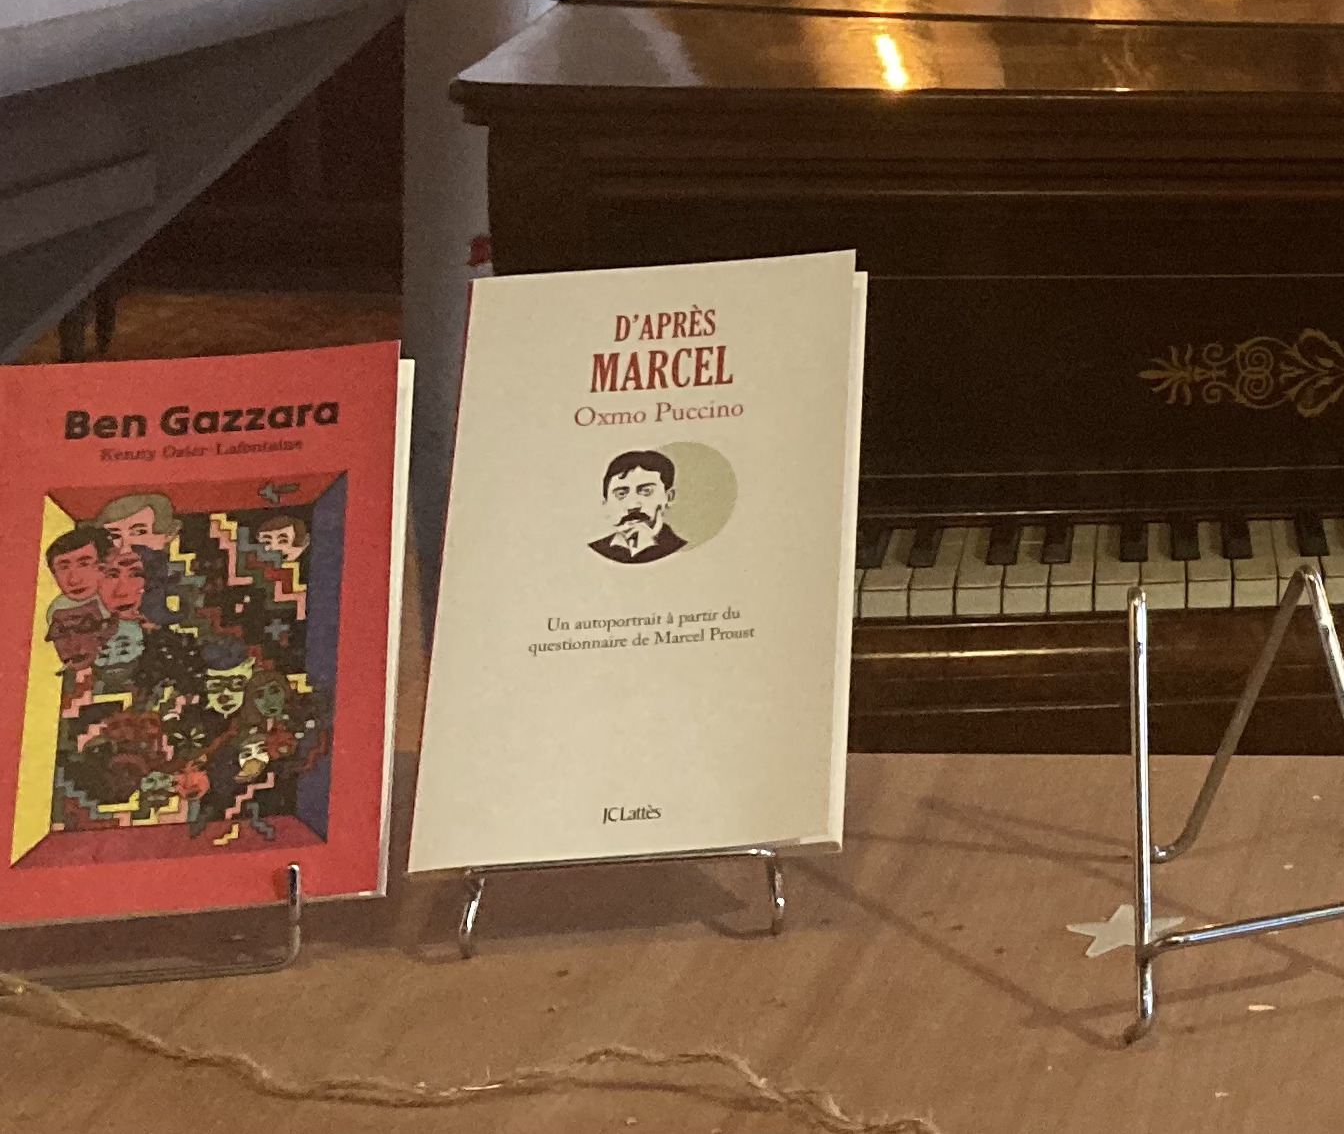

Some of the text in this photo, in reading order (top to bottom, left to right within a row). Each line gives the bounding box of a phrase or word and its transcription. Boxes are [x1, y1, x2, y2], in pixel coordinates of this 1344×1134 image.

[590, 345, 734, 393] MARCEL
[64, 401, 340, 440] Ben Gazzara
[574, 400, 744, 427] Oxmo Puccino
[547, 616, 571, 632] Un
[574, 612, 662, 634] autoportrait
[677, 609, 719, 628] partir
[721, 606, 741, 621] du
[528, 626, 756, 657] questionnaire de Marcel Proust
